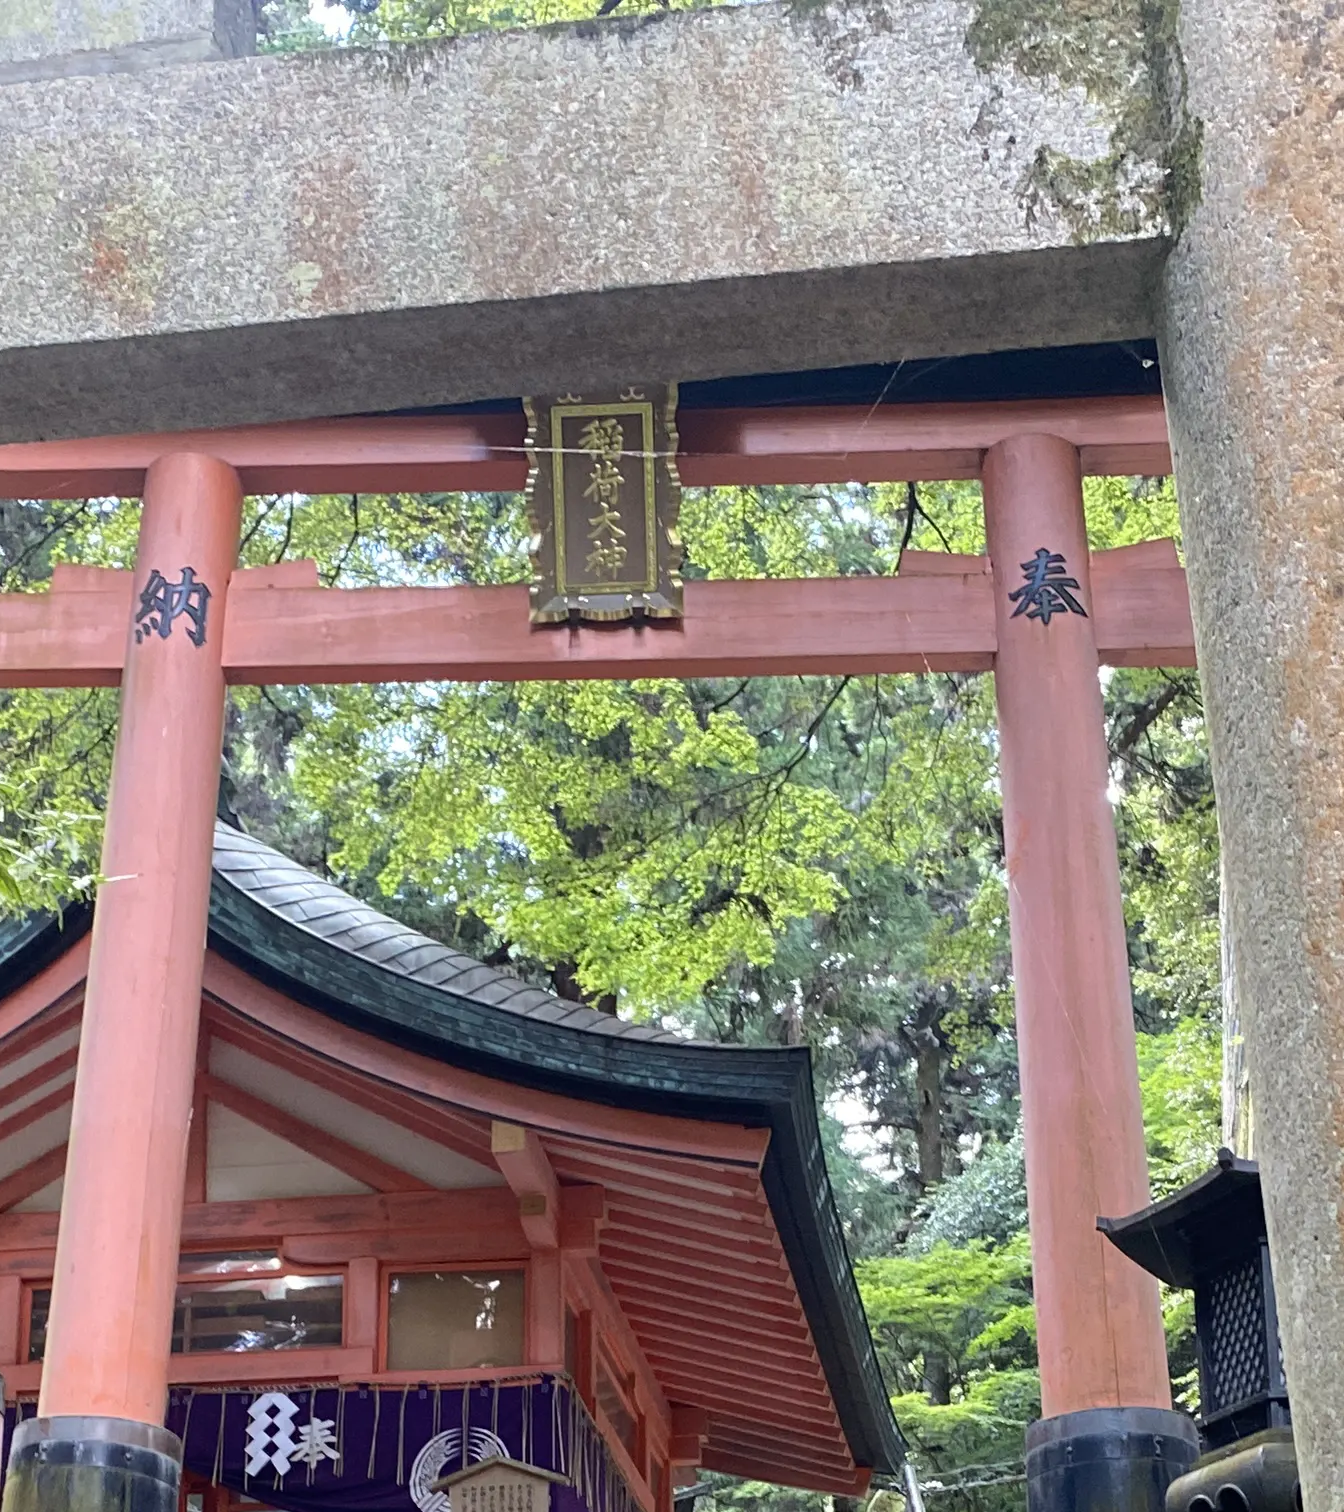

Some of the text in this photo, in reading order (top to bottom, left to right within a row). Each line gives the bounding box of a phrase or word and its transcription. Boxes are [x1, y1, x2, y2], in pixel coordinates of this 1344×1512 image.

[135, 567, 212, 648] 納
[1008, 547, 1089, 626] 奉
[289, 1416, 341, 1470] 奉
